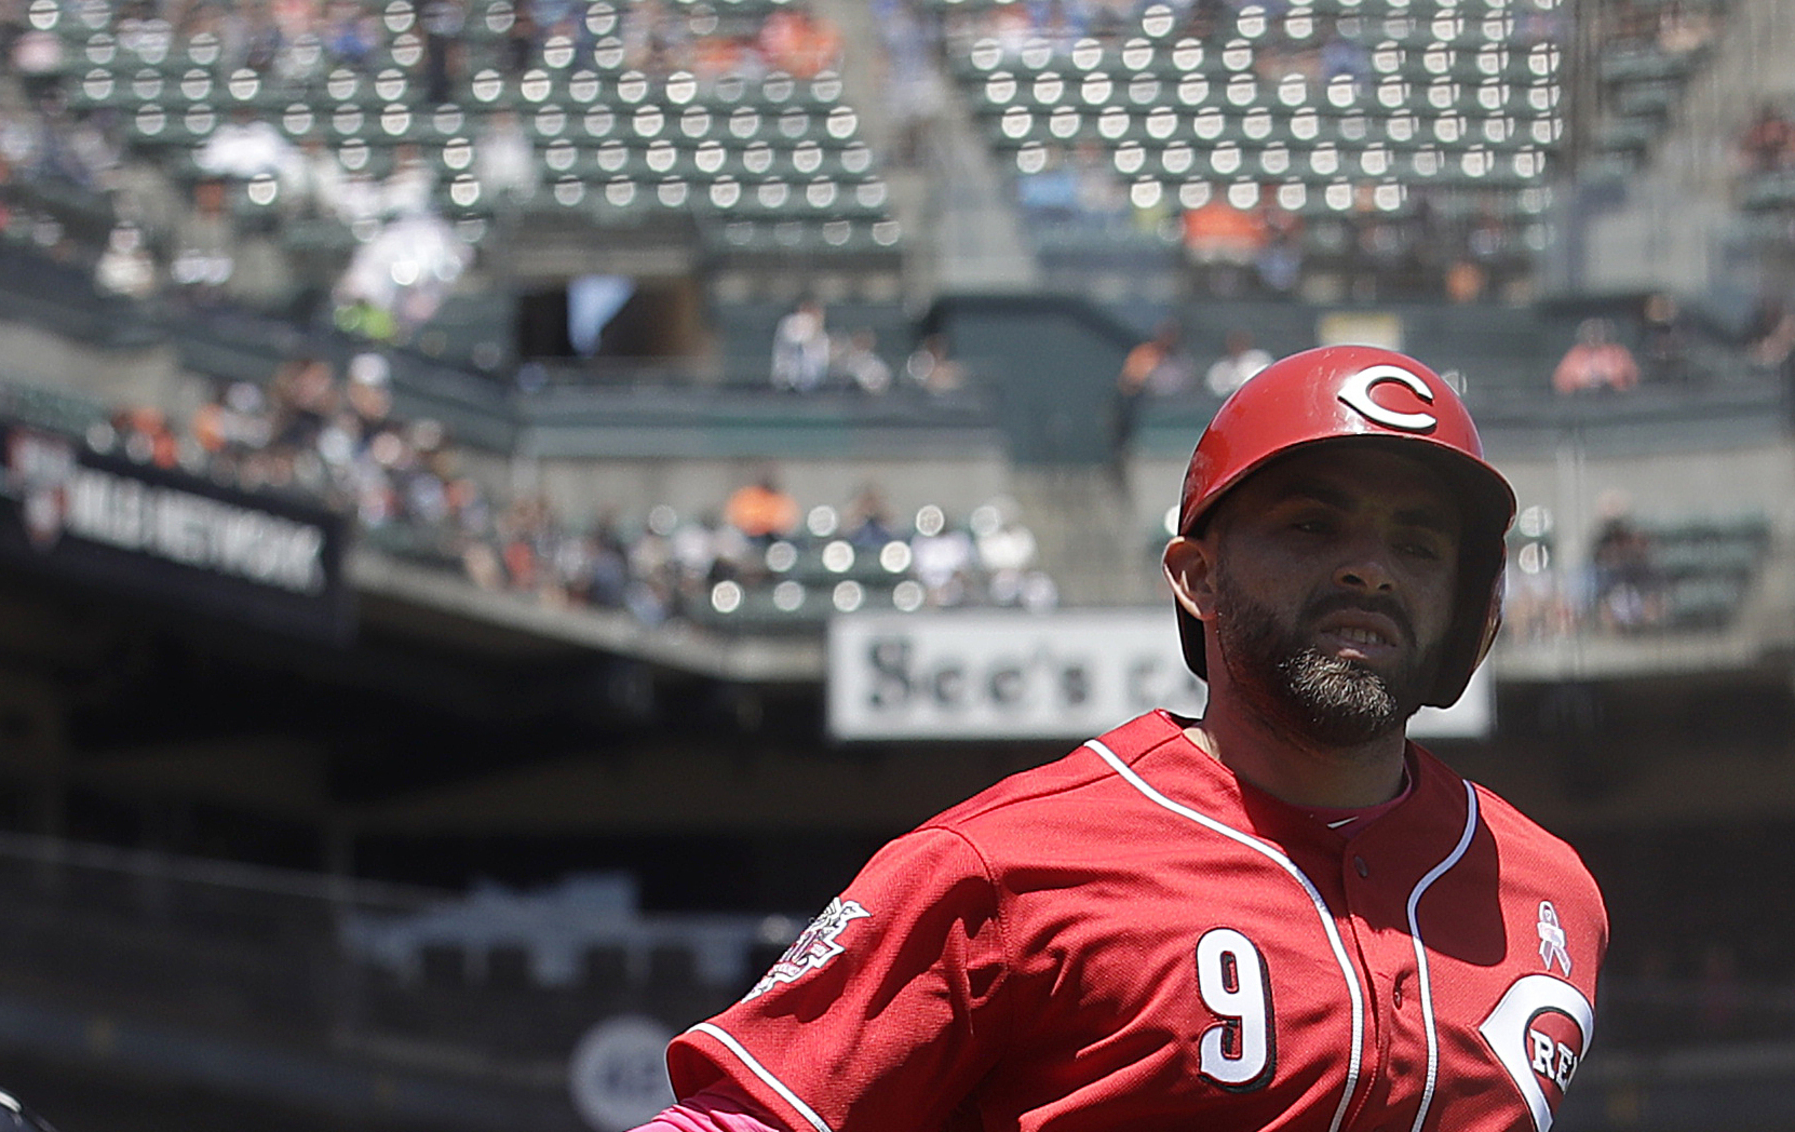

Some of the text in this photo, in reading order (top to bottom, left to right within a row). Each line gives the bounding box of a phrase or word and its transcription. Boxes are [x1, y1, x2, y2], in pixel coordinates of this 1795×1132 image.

[1336, 364, 1437, 434] C
[866, 636, 1093, 709] See's
[1196, 926, 1277, 1093] 9
[1528, 1027, 1578, 1095] RE
